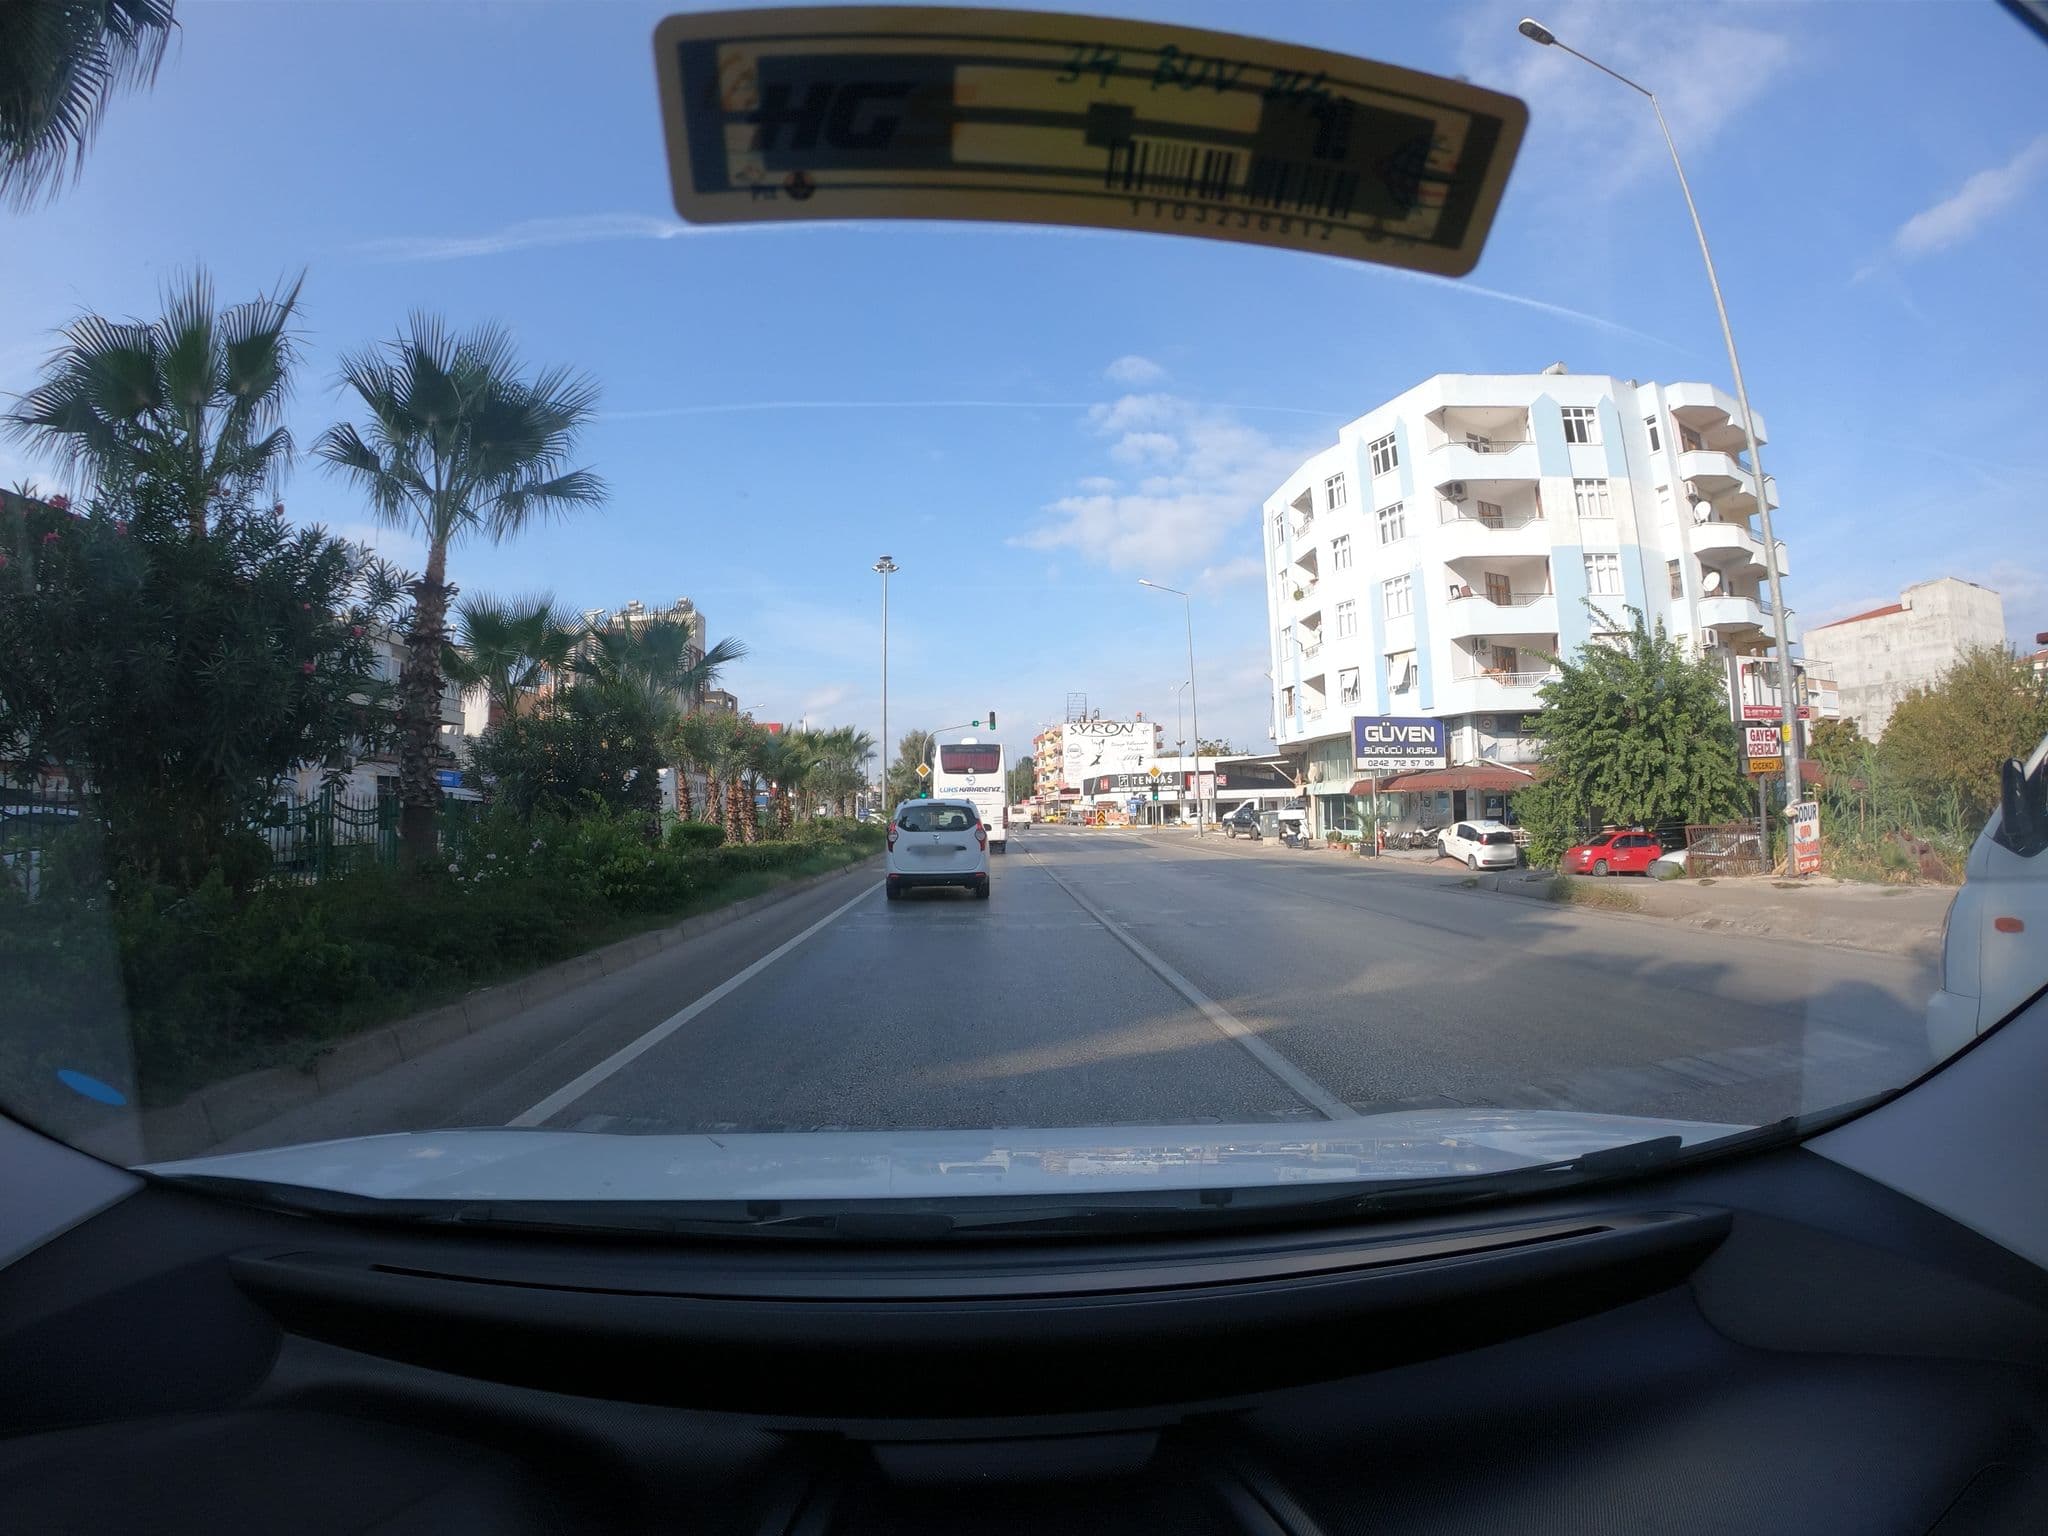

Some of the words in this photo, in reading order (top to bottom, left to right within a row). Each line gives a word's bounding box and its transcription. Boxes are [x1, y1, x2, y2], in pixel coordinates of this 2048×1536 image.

[1069, 722, 1134, 737] SYRON
[1364, 721, 1435, 742] GÜVEN
[1750, 729, 1777, 741] GAYEM
[1406, 746, 1437, 754] KURSU
[1367, 759, 1390, 767] 0242
[1394, 759, 1407, 767] 712
[1410, 759, 1420, 767] 57
[1424, 759, 1435, 767] 06
